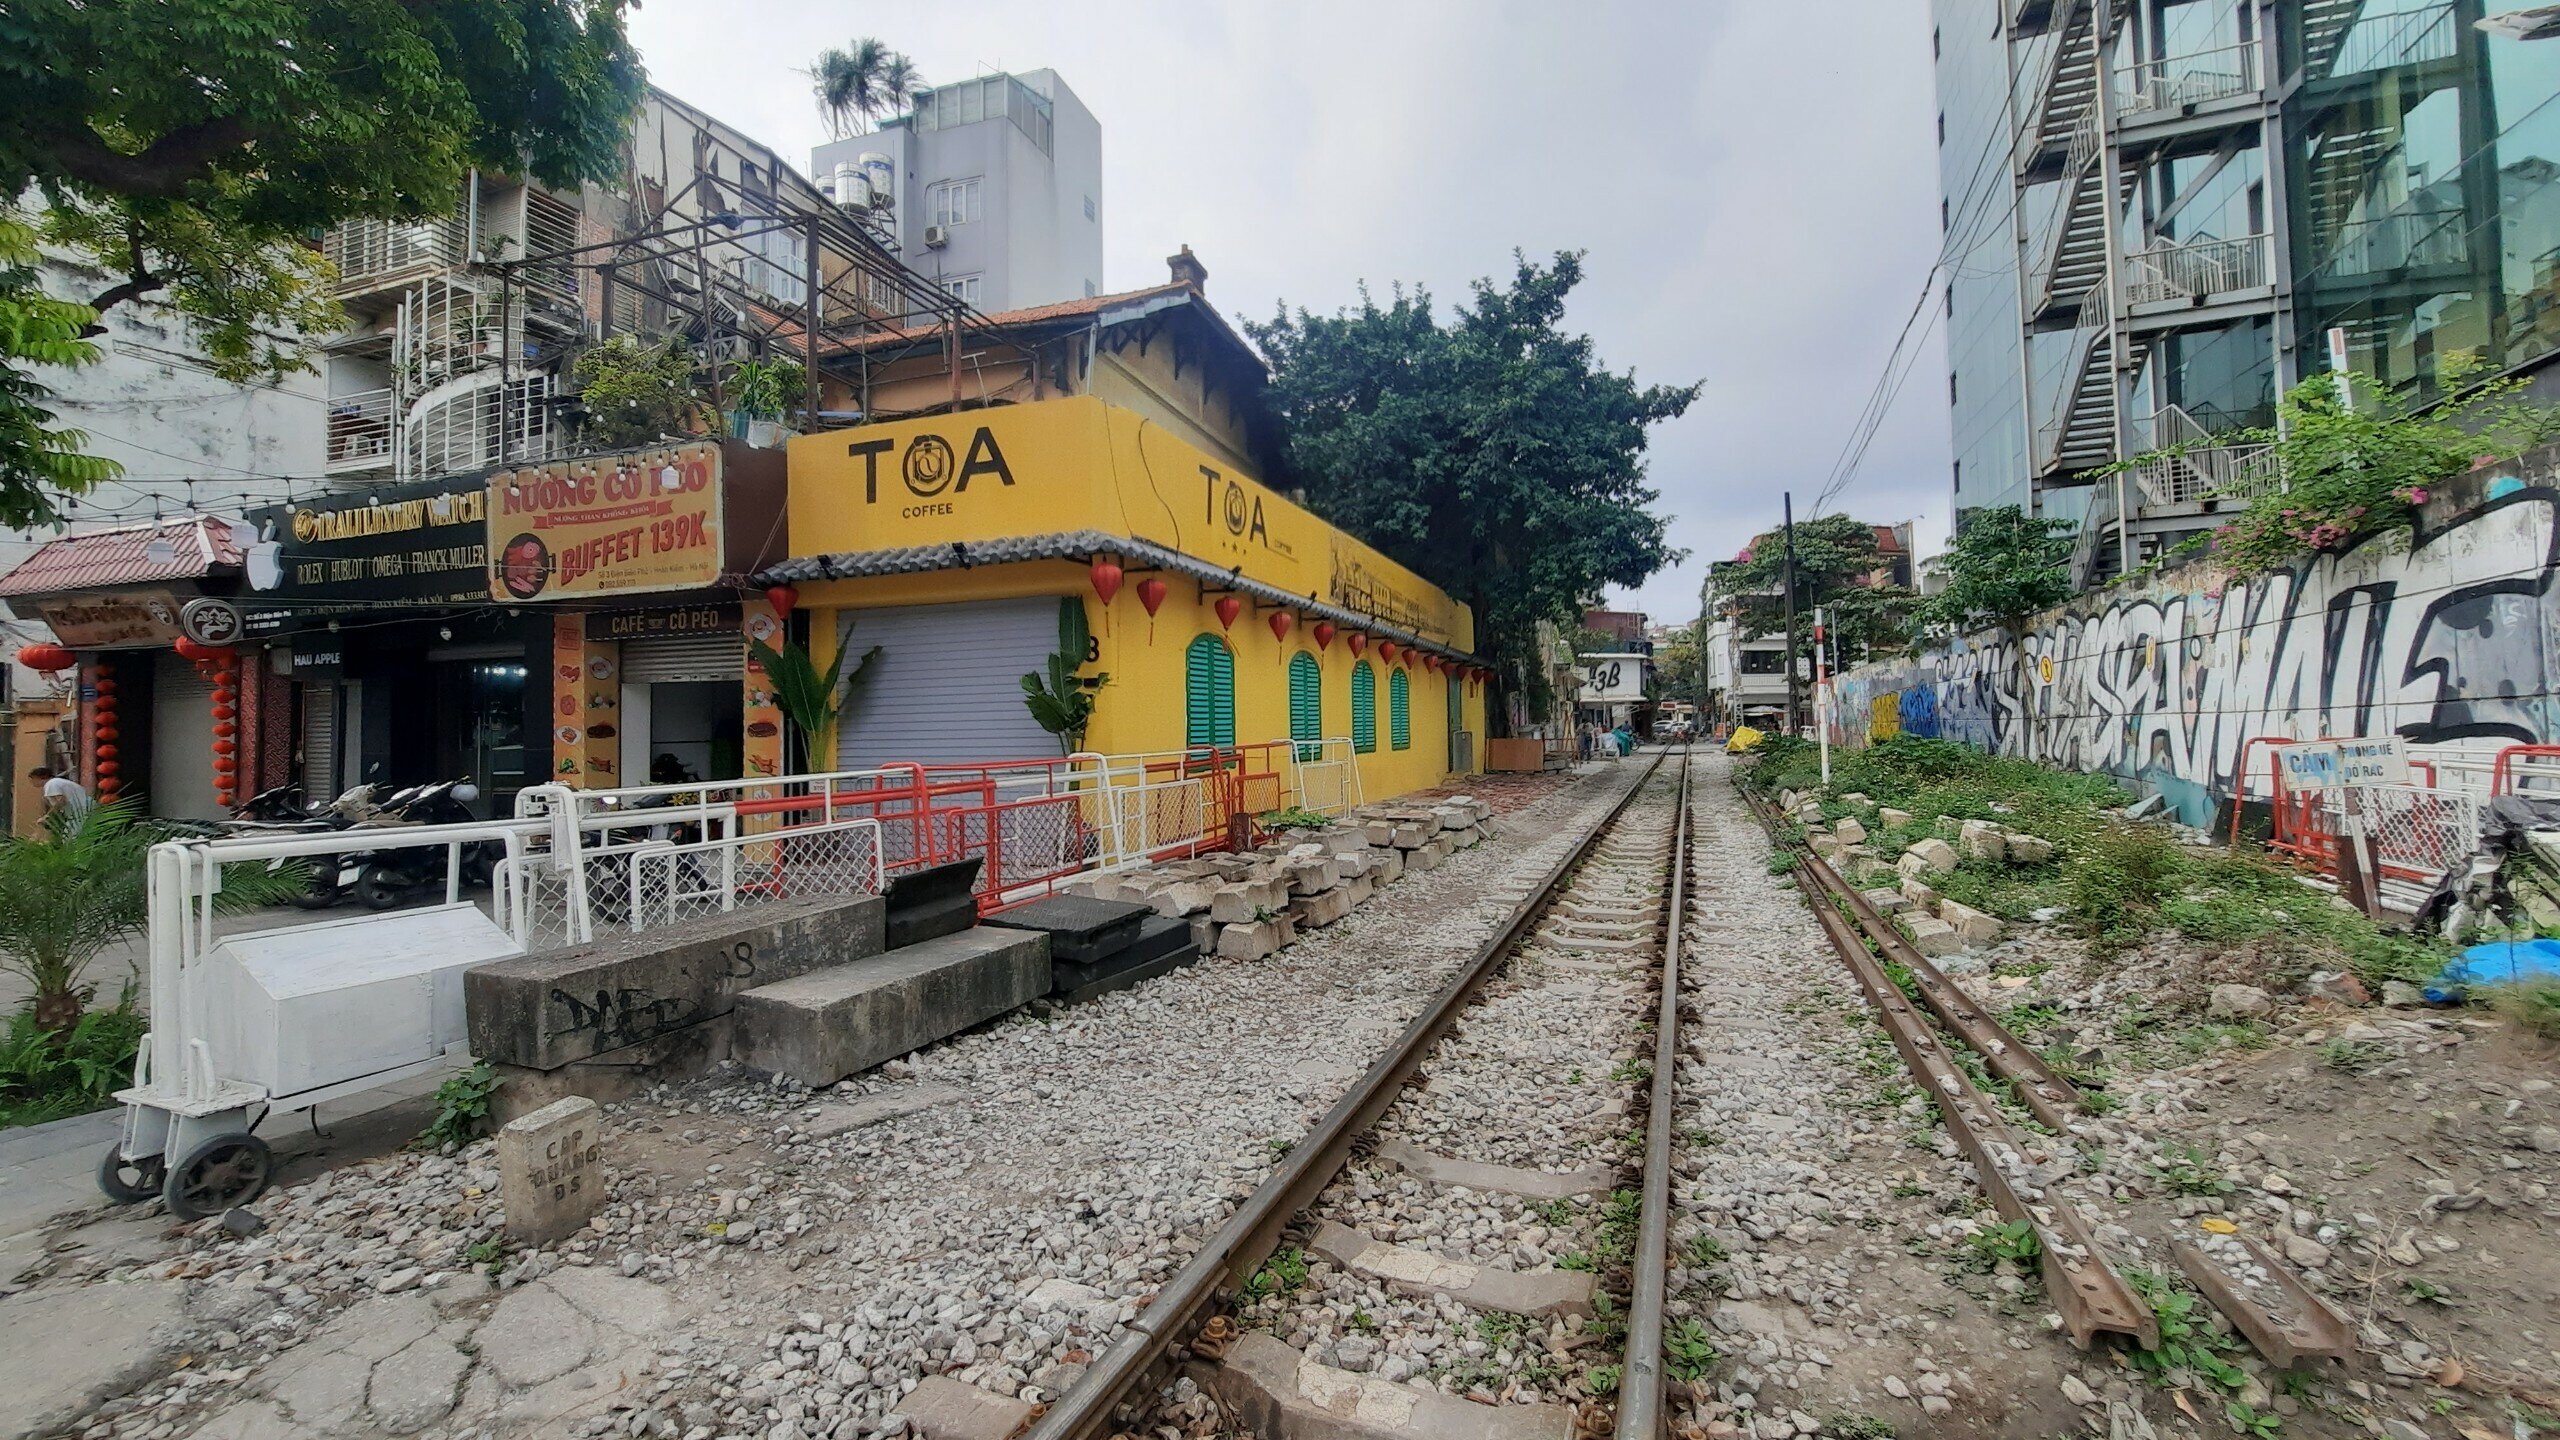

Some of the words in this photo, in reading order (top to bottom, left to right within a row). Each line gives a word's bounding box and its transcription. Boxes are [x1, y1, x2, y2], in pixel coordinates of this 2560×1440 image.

[848, 426, 1016, 504] TOA
[580, 513, 601, 522] THAN
[902, 503, 954, 519] COFFEE
[1199, 464, 1268, 548] TOA
[561, 526, 644, 587] BUFFET
[650, 510, 707, 554] 139K
[297, 562, 323, 585] ROLEX
[331, 556, 364, 583] HUBLOT
[372, 553, 403, 578] OMEGA
[411, 548, 447, 575] FRANCK
[449, 544, 485, 570] MULLER
[611, 610, 645, 634] CAFÉ
[669, 608, 687, 630] CÔ
[294, 654, 312, 666] HAU
[314, 652, 341, 665] APPLE
[2288, 747, 2332, 773] CẤM
